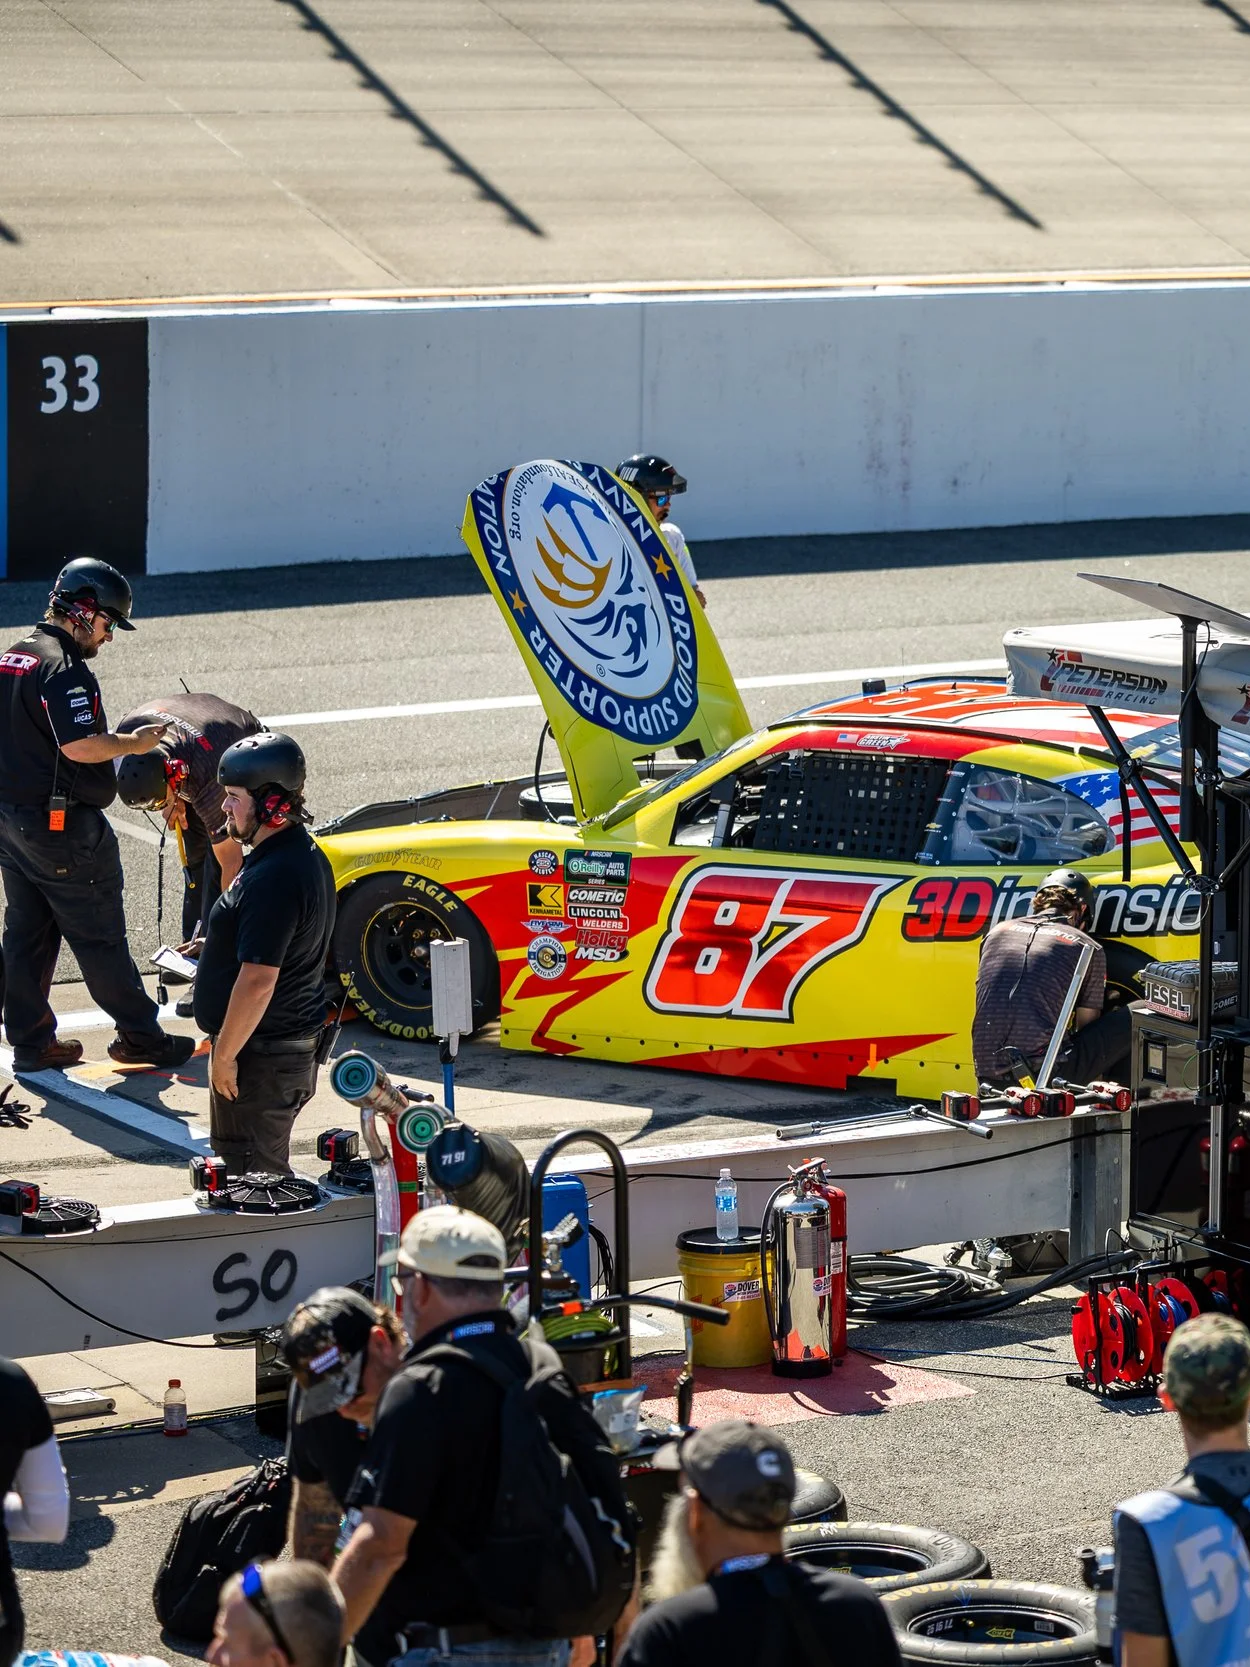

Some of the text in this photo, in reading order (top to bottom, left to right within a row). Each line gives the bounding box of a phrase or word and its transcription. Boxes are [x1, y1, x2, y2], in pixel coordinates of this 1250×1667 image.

[40, 354, 100, 414] 33
[528, 593, 694, 736] PROUD SUPPORTER
[1053, 662, 1168, 696] PETERSON
[1104, 690, 1156, 705] RACING
[606, 869, 625, 877] PARTS
[608, 862, 625, 870] AUTO
[402, 874, 459, 913] EAGLE
[568, 887, 625, 904] COMETIC
[529, 908, 563, 916] KENNAMETAL
[571, 907, 619, 919] LINCOLN
[582, 919, 624, 930] WELDERS
[531, 938, 563, 953] CHAMPION
[576, 930, 629, 952] Holley
[643, 864, 912, 1021] 87
[575, 947, 621, 961] MSD
[531, 961, 564, 978] IRRIGATION
[1144, 981, 1191, 1013] JESEL
[1213, 994, 1238, 1011] COMET
[441, 1150, 466, 1166] 71 91
[737, 1280, 760, 1292] DOVER
